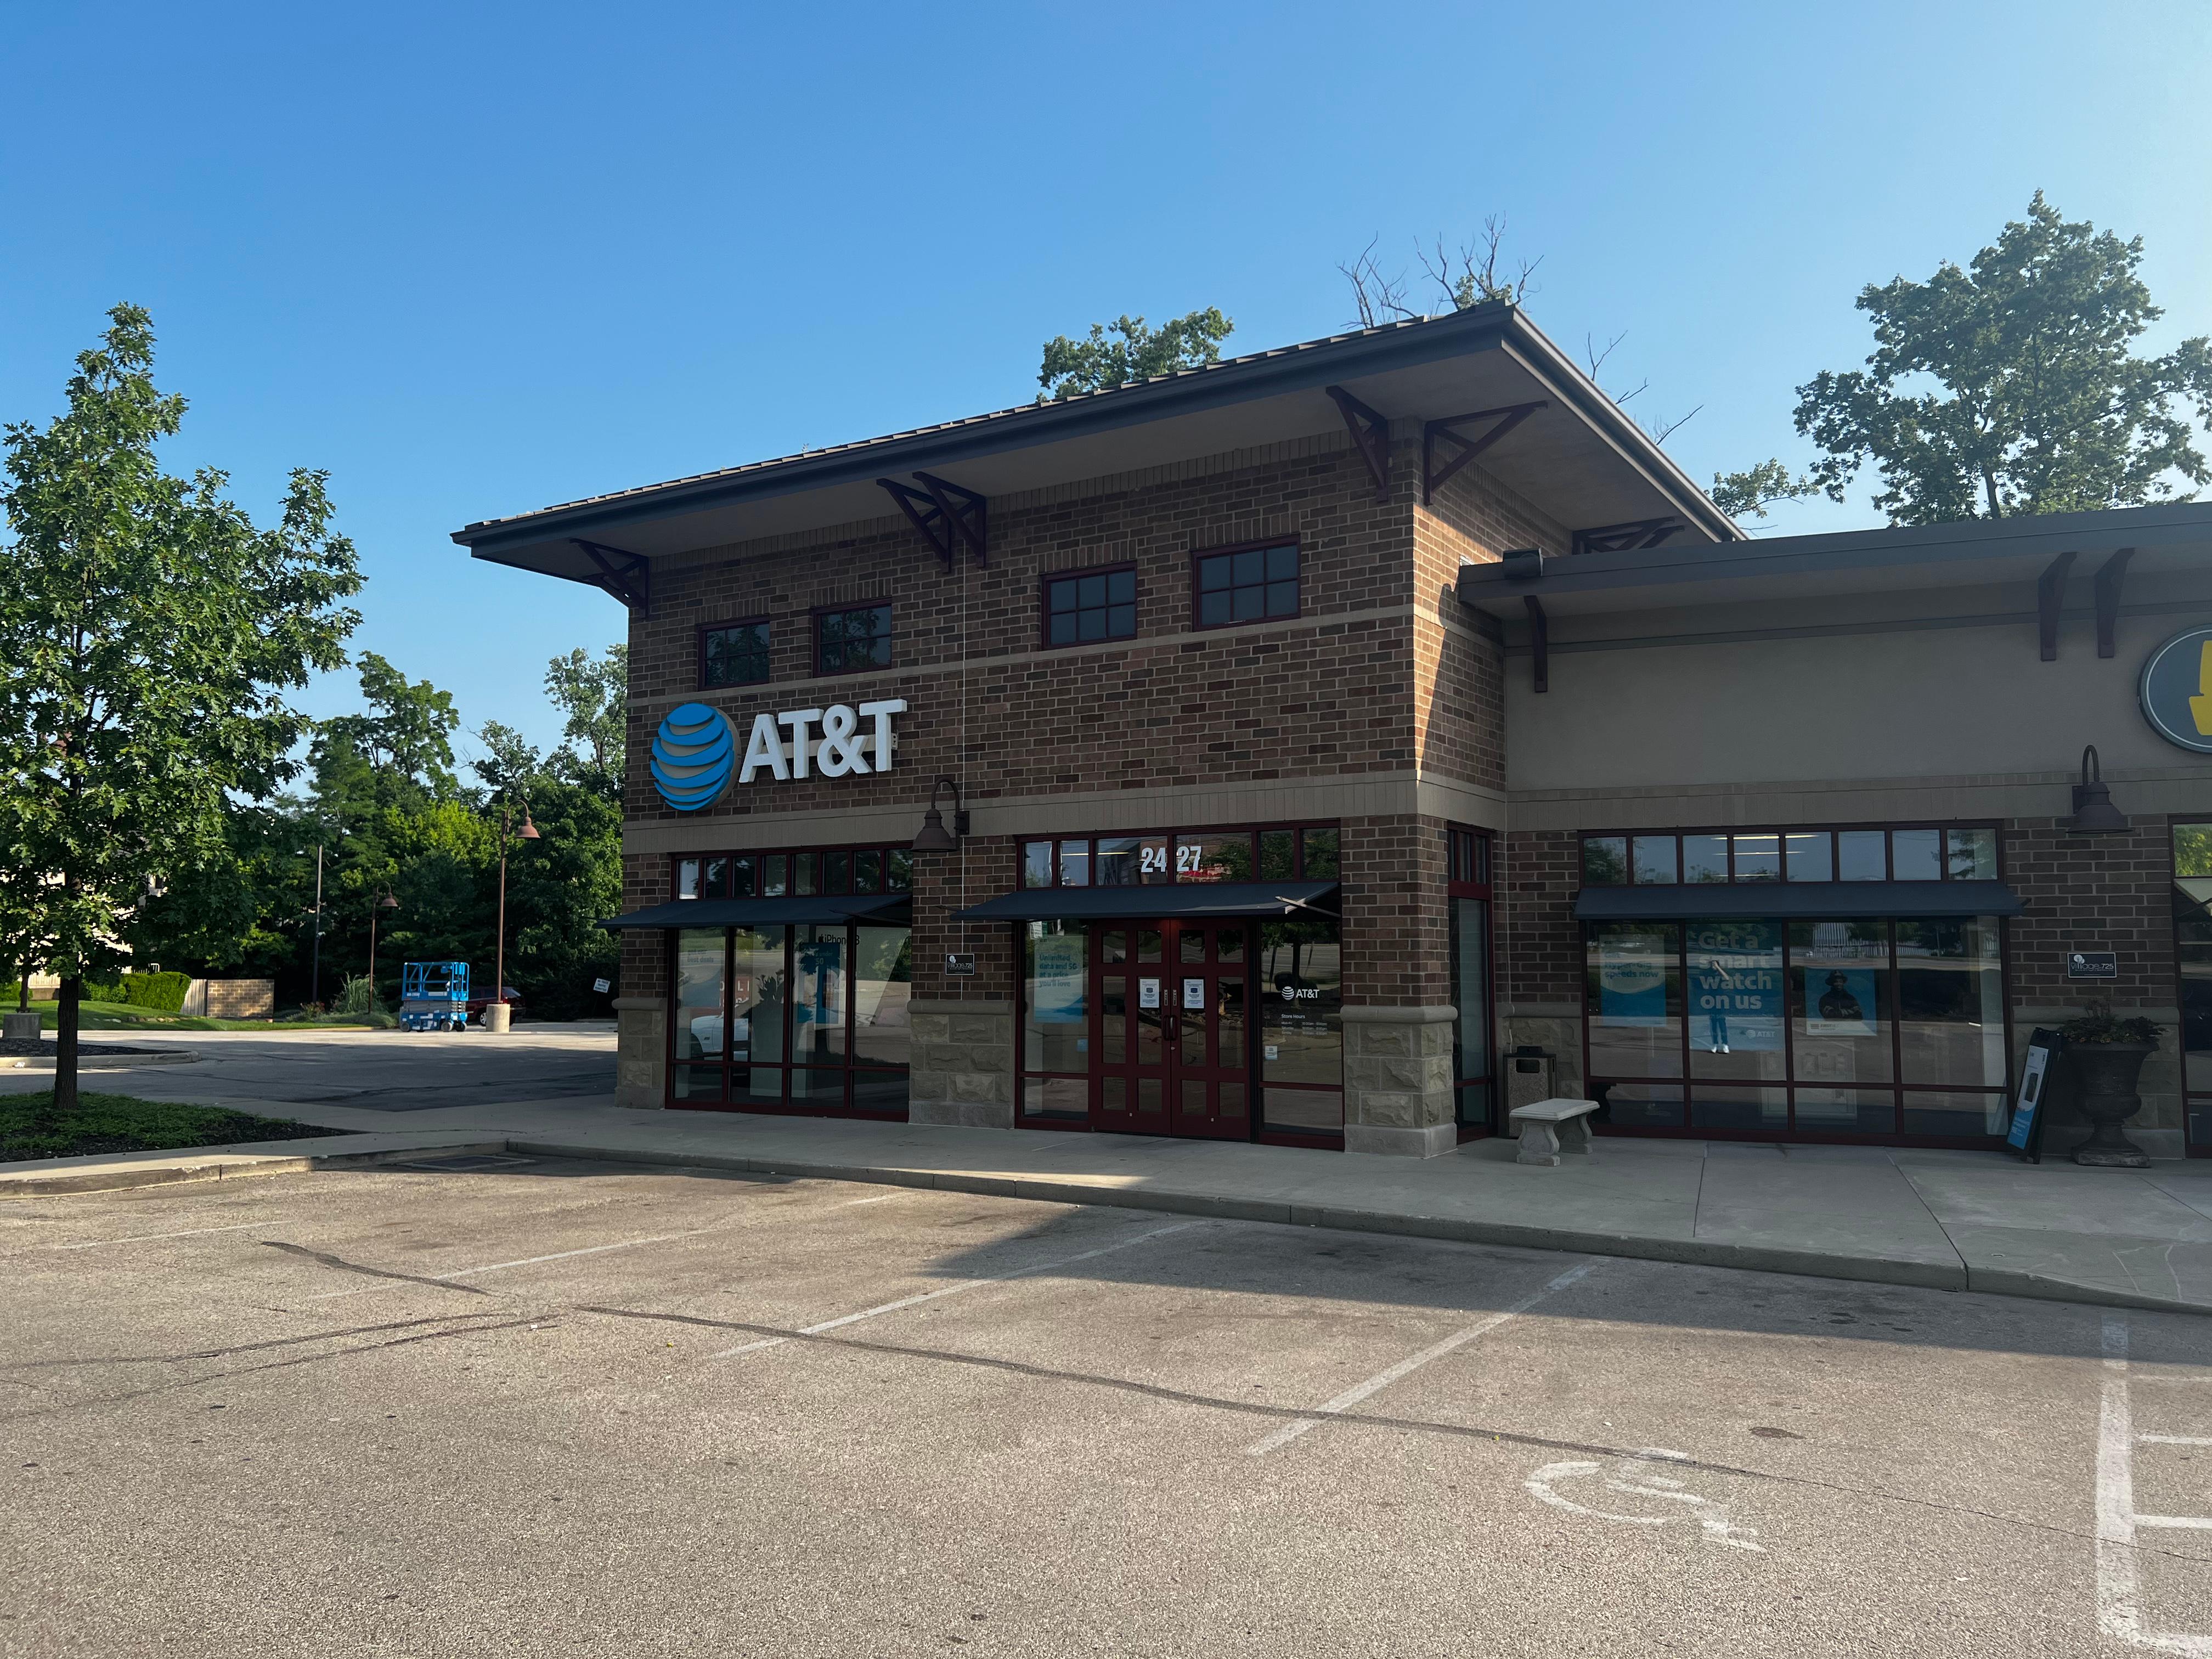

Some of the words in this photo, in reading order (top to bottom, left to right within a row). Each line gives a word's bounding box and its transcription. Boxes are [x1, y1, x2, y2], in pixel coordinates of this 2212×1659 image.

[738, 698, 907, 783] AT&T
[825, 934, 848, 945] iPhon
[1699, 931, 1740, 949] Get
[1745, 935, 1759, 949] a
[1699, 955, 1770, 969] smart
[1605, 970, 1637, 979] speeds
[1700, 970, 1772, 990] watch
[1296, 989, 1320, 998] AT&T
[1700, 994, 1730, 1009] on
[1735, 995, 1762, 1009] us
